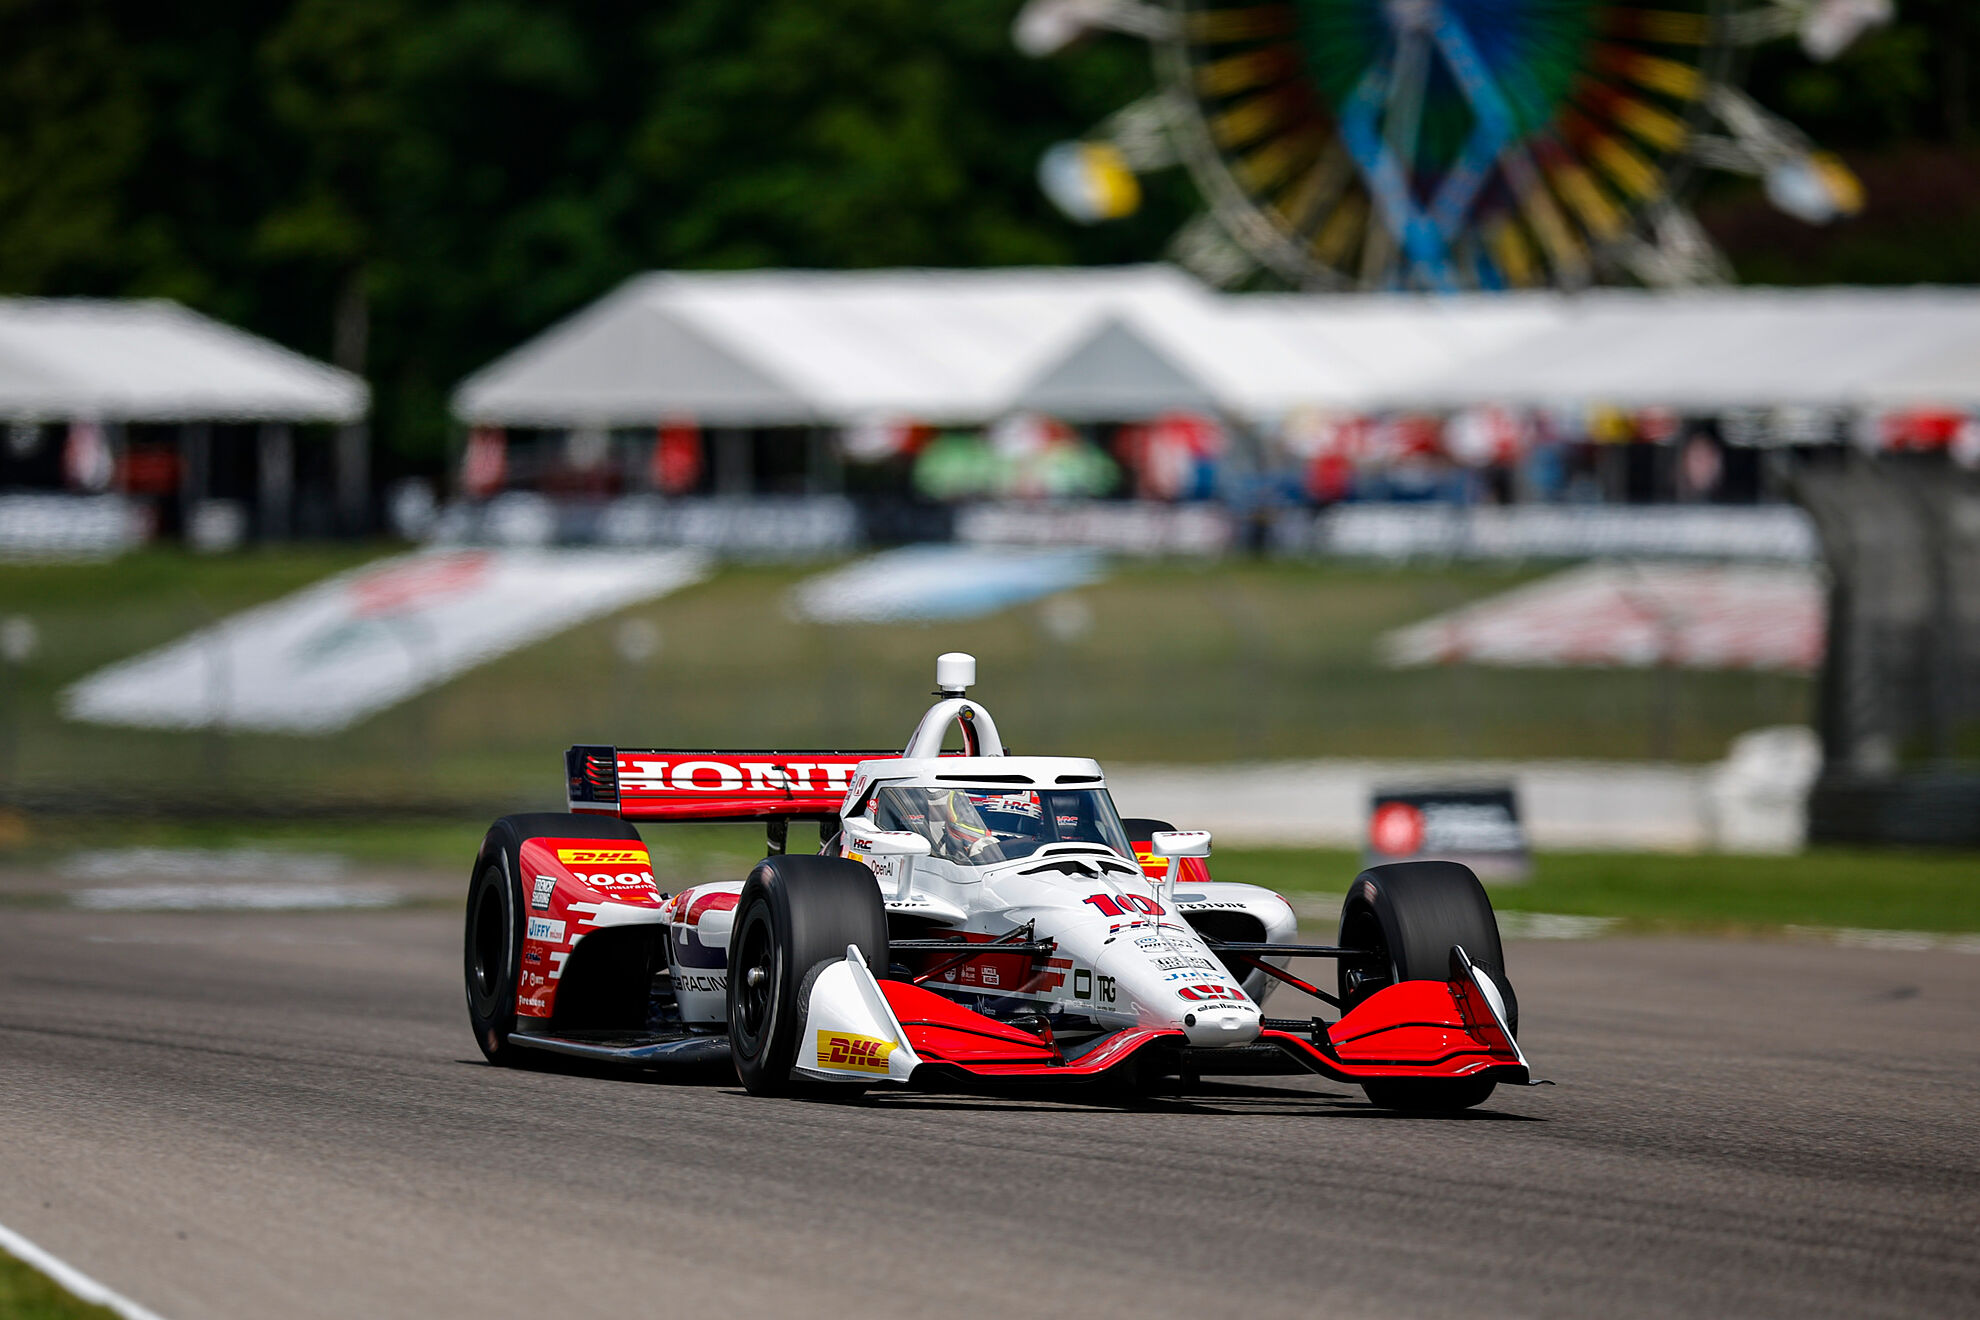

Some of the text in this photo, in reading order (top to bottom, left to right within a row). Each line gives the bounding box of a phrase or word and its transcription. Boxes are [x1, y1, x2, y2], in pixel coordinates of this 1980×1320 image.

[853, 838, 873, 849] HRC
[572, 852, 637, 862] DHL
[871, 860, 894, 877] OpenAI
[1082, 893, 1166, 917] 10
[529, 919, 551, 938] JIFFY
[1097, 975, 1116, 1003] TRG
[1197, 1003, 1256, 1013] dallara
[829, 1037, 883, 1067] DHL
